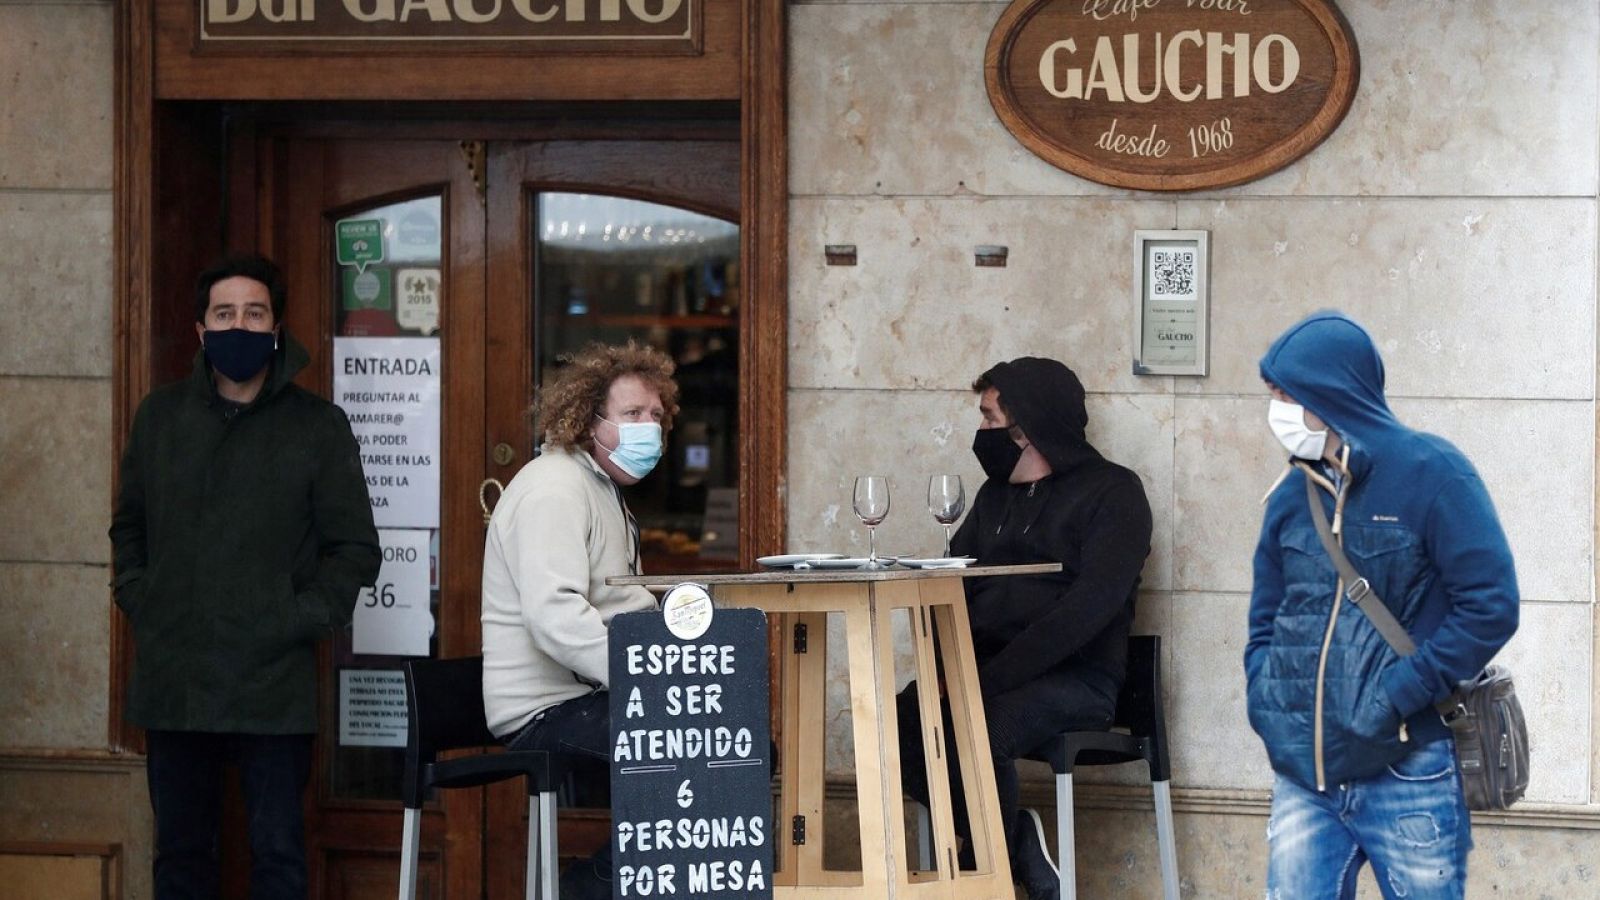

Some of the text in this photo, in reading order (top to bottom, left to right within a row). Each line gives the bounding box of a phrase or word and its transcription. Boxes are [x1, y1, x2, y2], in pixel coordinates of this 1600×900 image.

[1039, 29, 1300, 103] GAUCHO
[1094, 117, 1234, 159] desde 1968
[344, 357, 431, 376] ENTRADA
[343, 392, 421, 403] PREGUNTAR AL
[373, 435, 408, 446] PODER
[395, 455, 410, 466] EN
[412, 455, 431, 466] LAS
[380, 476, 394, 487] DE
[396, 476, 409, 487] LA
[626, 644, 736, 675] ESPERE
[625, 683, 723, 719] A SER
[614, 726, 753, 763] ATENDIDO
[676, 779, 694, 808] 6
[617, 815, 765, 853] PERSONAS
[619, 859, 765, 896] POR MESA
